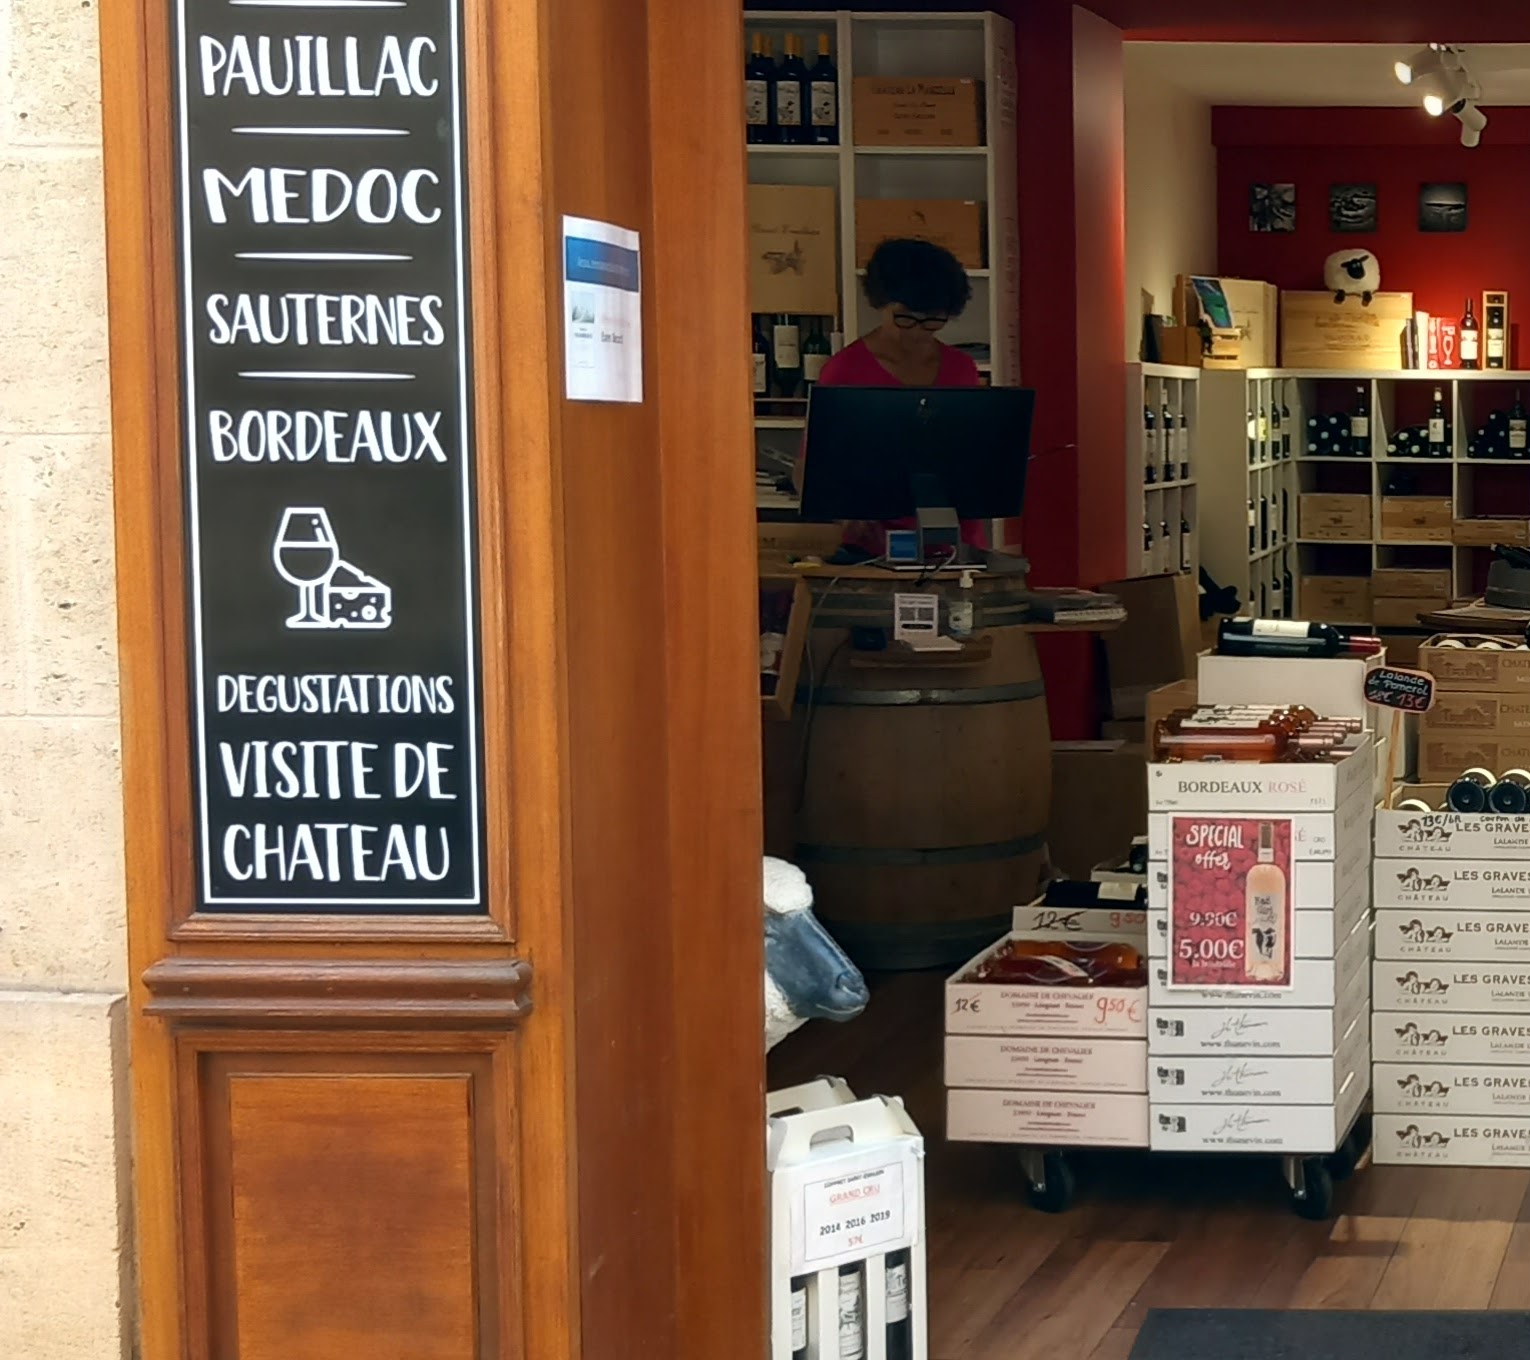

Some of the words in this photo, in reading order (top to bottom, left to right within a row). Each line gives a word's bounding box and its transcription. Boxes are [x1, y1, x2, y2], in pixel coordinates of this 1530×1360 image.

[200, 35, 438, 96] PAUILLAC
[203, 168, 441, 223] MEDOC
[207, 294, 444, 345] SAUTERNES
[210, 411, 447, 462] BORDEAUX
[218, 675, 454, 713] DEGUSTATIONS
[220, 741, 381, 799] VISITE
[395, 742, 456, 799] DE
[1178, 781, 1262, 793] BORDEAUX
[1268, 779, 1306, 793] ROSÉ
[1186, 825, 1244, 848] SPECIAL
[1455, 823, 1481, 833] LES
[224, 824, 449, 881] CHATEAU
[1195, 850, 1231, 870] offer
[1454, 871, 1479, 881] LES
[1456, 923, 1482, 933] LES
[1179, 939, 1244, 959] 5.00€
[1453, 975, 1478, 984] LES
[1452, 1026, 1477, 1036] LES
[1454, 1078, 1479, 1088] LES
[1453, 1128, 1479, 1138] LES
[829, 1188, 861, 1204] GRAND
[819, 1222, 841, 1236] 2014
[845, 1216, 866, 1230] 2016
[869, 1210, 891, 1224] 2019
